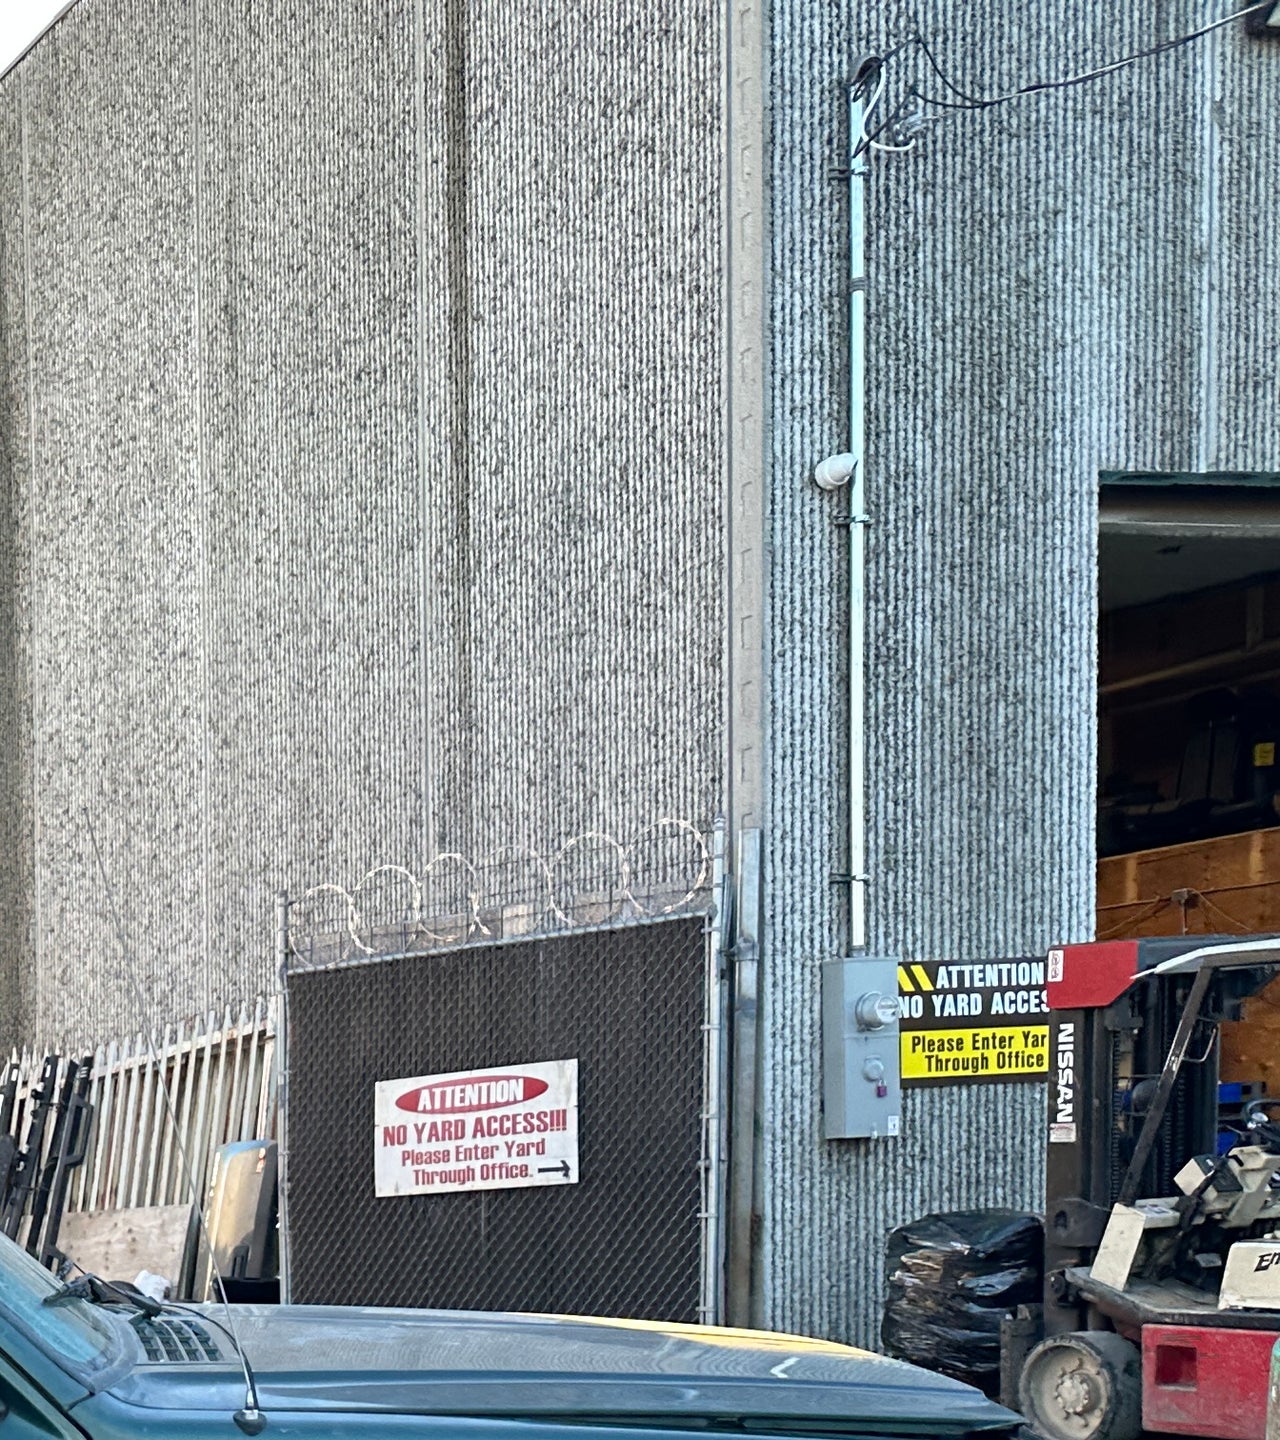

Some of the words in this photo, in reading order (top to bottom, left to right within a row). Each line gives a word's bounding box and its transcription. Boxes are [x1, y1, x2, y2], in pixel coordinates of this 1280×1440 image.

[935, 962, 1045, 989] ATTENTION
[898, 994, 924, 1019] NO
[931, 993, 983, 1017] YARD
[990, 989, 1051, 1015] ACCES
[911, 1035, 964, 1054] Please
[972, 1033, 1015, 1051] Enter
[1022, 1030, 1047, 1048] Yar
[925, 1054, 989, 1073] Through
[996, 1051, 1044, 1069] Office
[1057, 1023, 1075, 1122] NISSAN
[417, 1078, 524, 1112] ATTENTION
[383, 1124, 407, 1147] NO
[413, 1118, 466, 1144] YARD
[472, 1109, 567, 1139] ACCESS!!!
[402, 1149, 450, 1167] Please
[455, 1143, 500, 1163] Enter
[504, 1138, 546, 1158] Yard
[413, 1164, 475, 1186] Through
